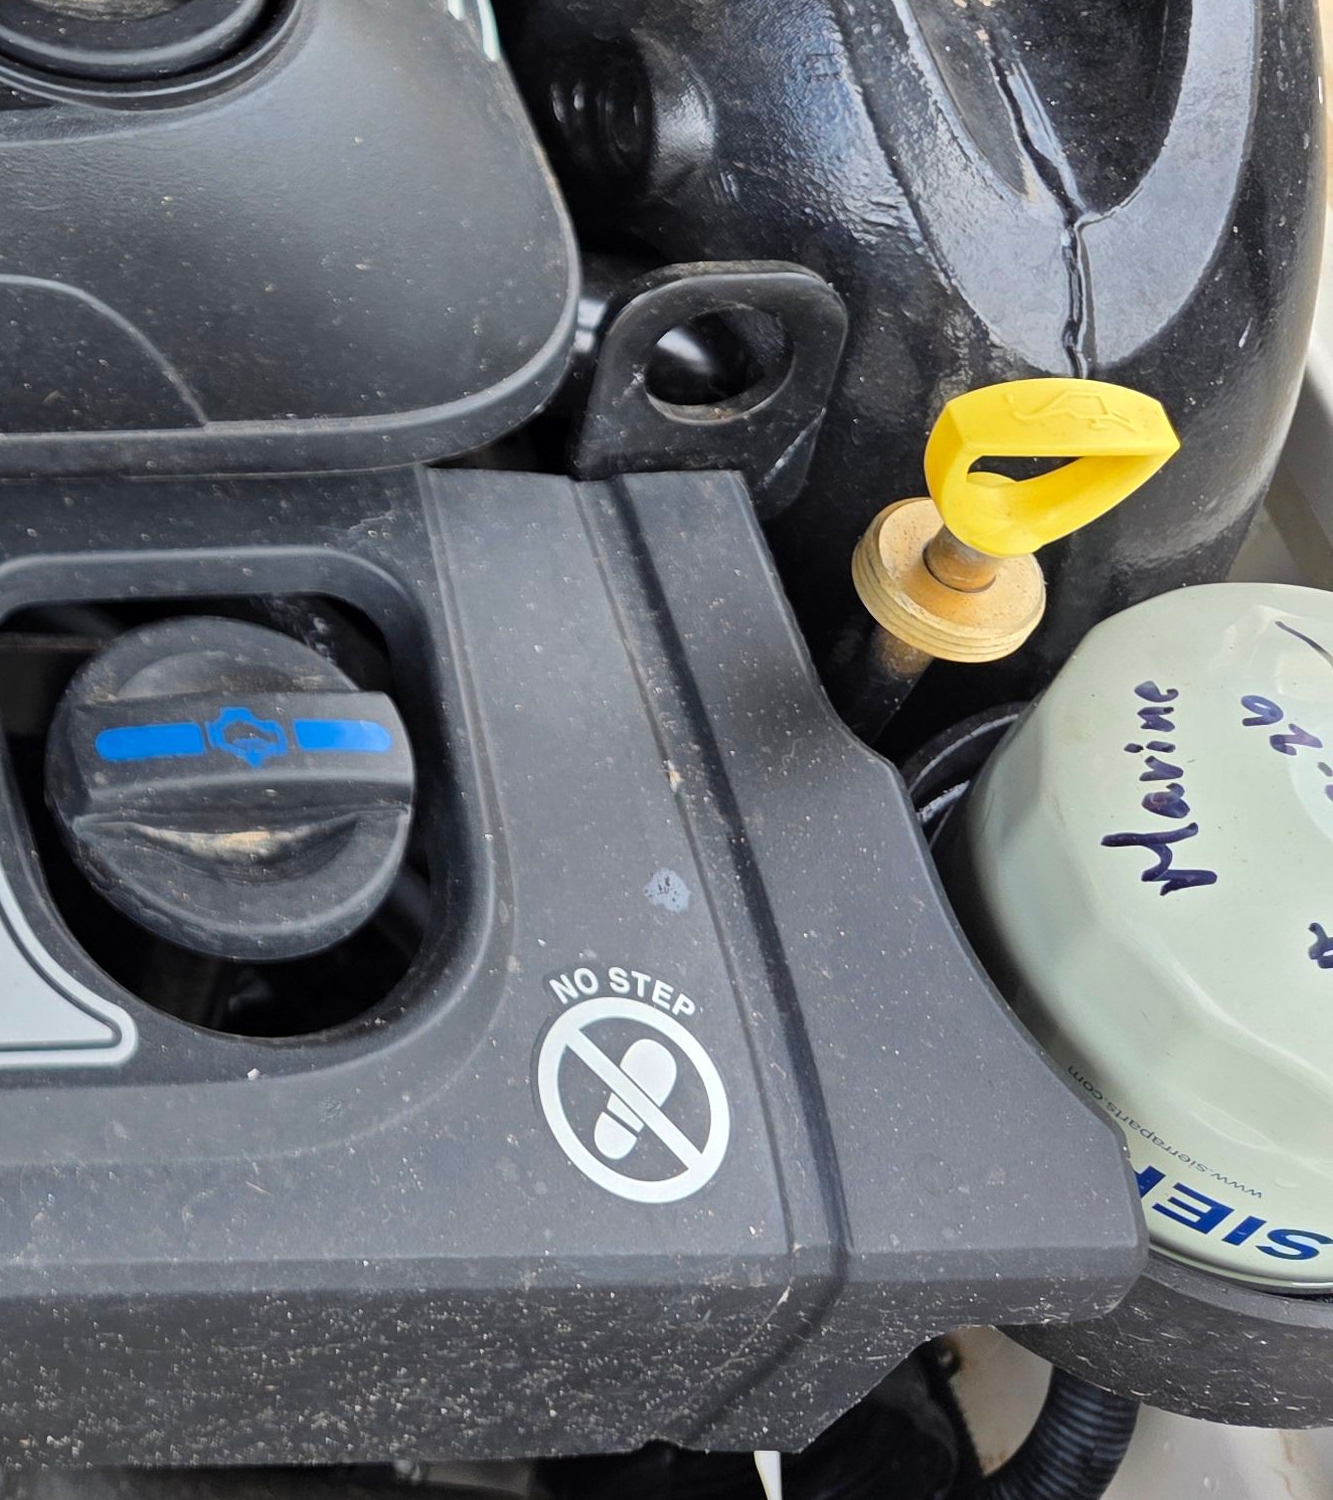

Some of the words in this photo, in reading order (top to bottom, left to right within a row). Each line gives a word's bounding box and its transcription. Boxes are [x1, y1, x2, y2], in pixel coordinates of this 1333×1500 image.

[1101, 680, 1219, 896] Marine
[548, 967, 599, 1004] NO
[607, 966, 696, 1016] STEP
[1068, 1065, 1263, 1199] www.sierraparts.com
